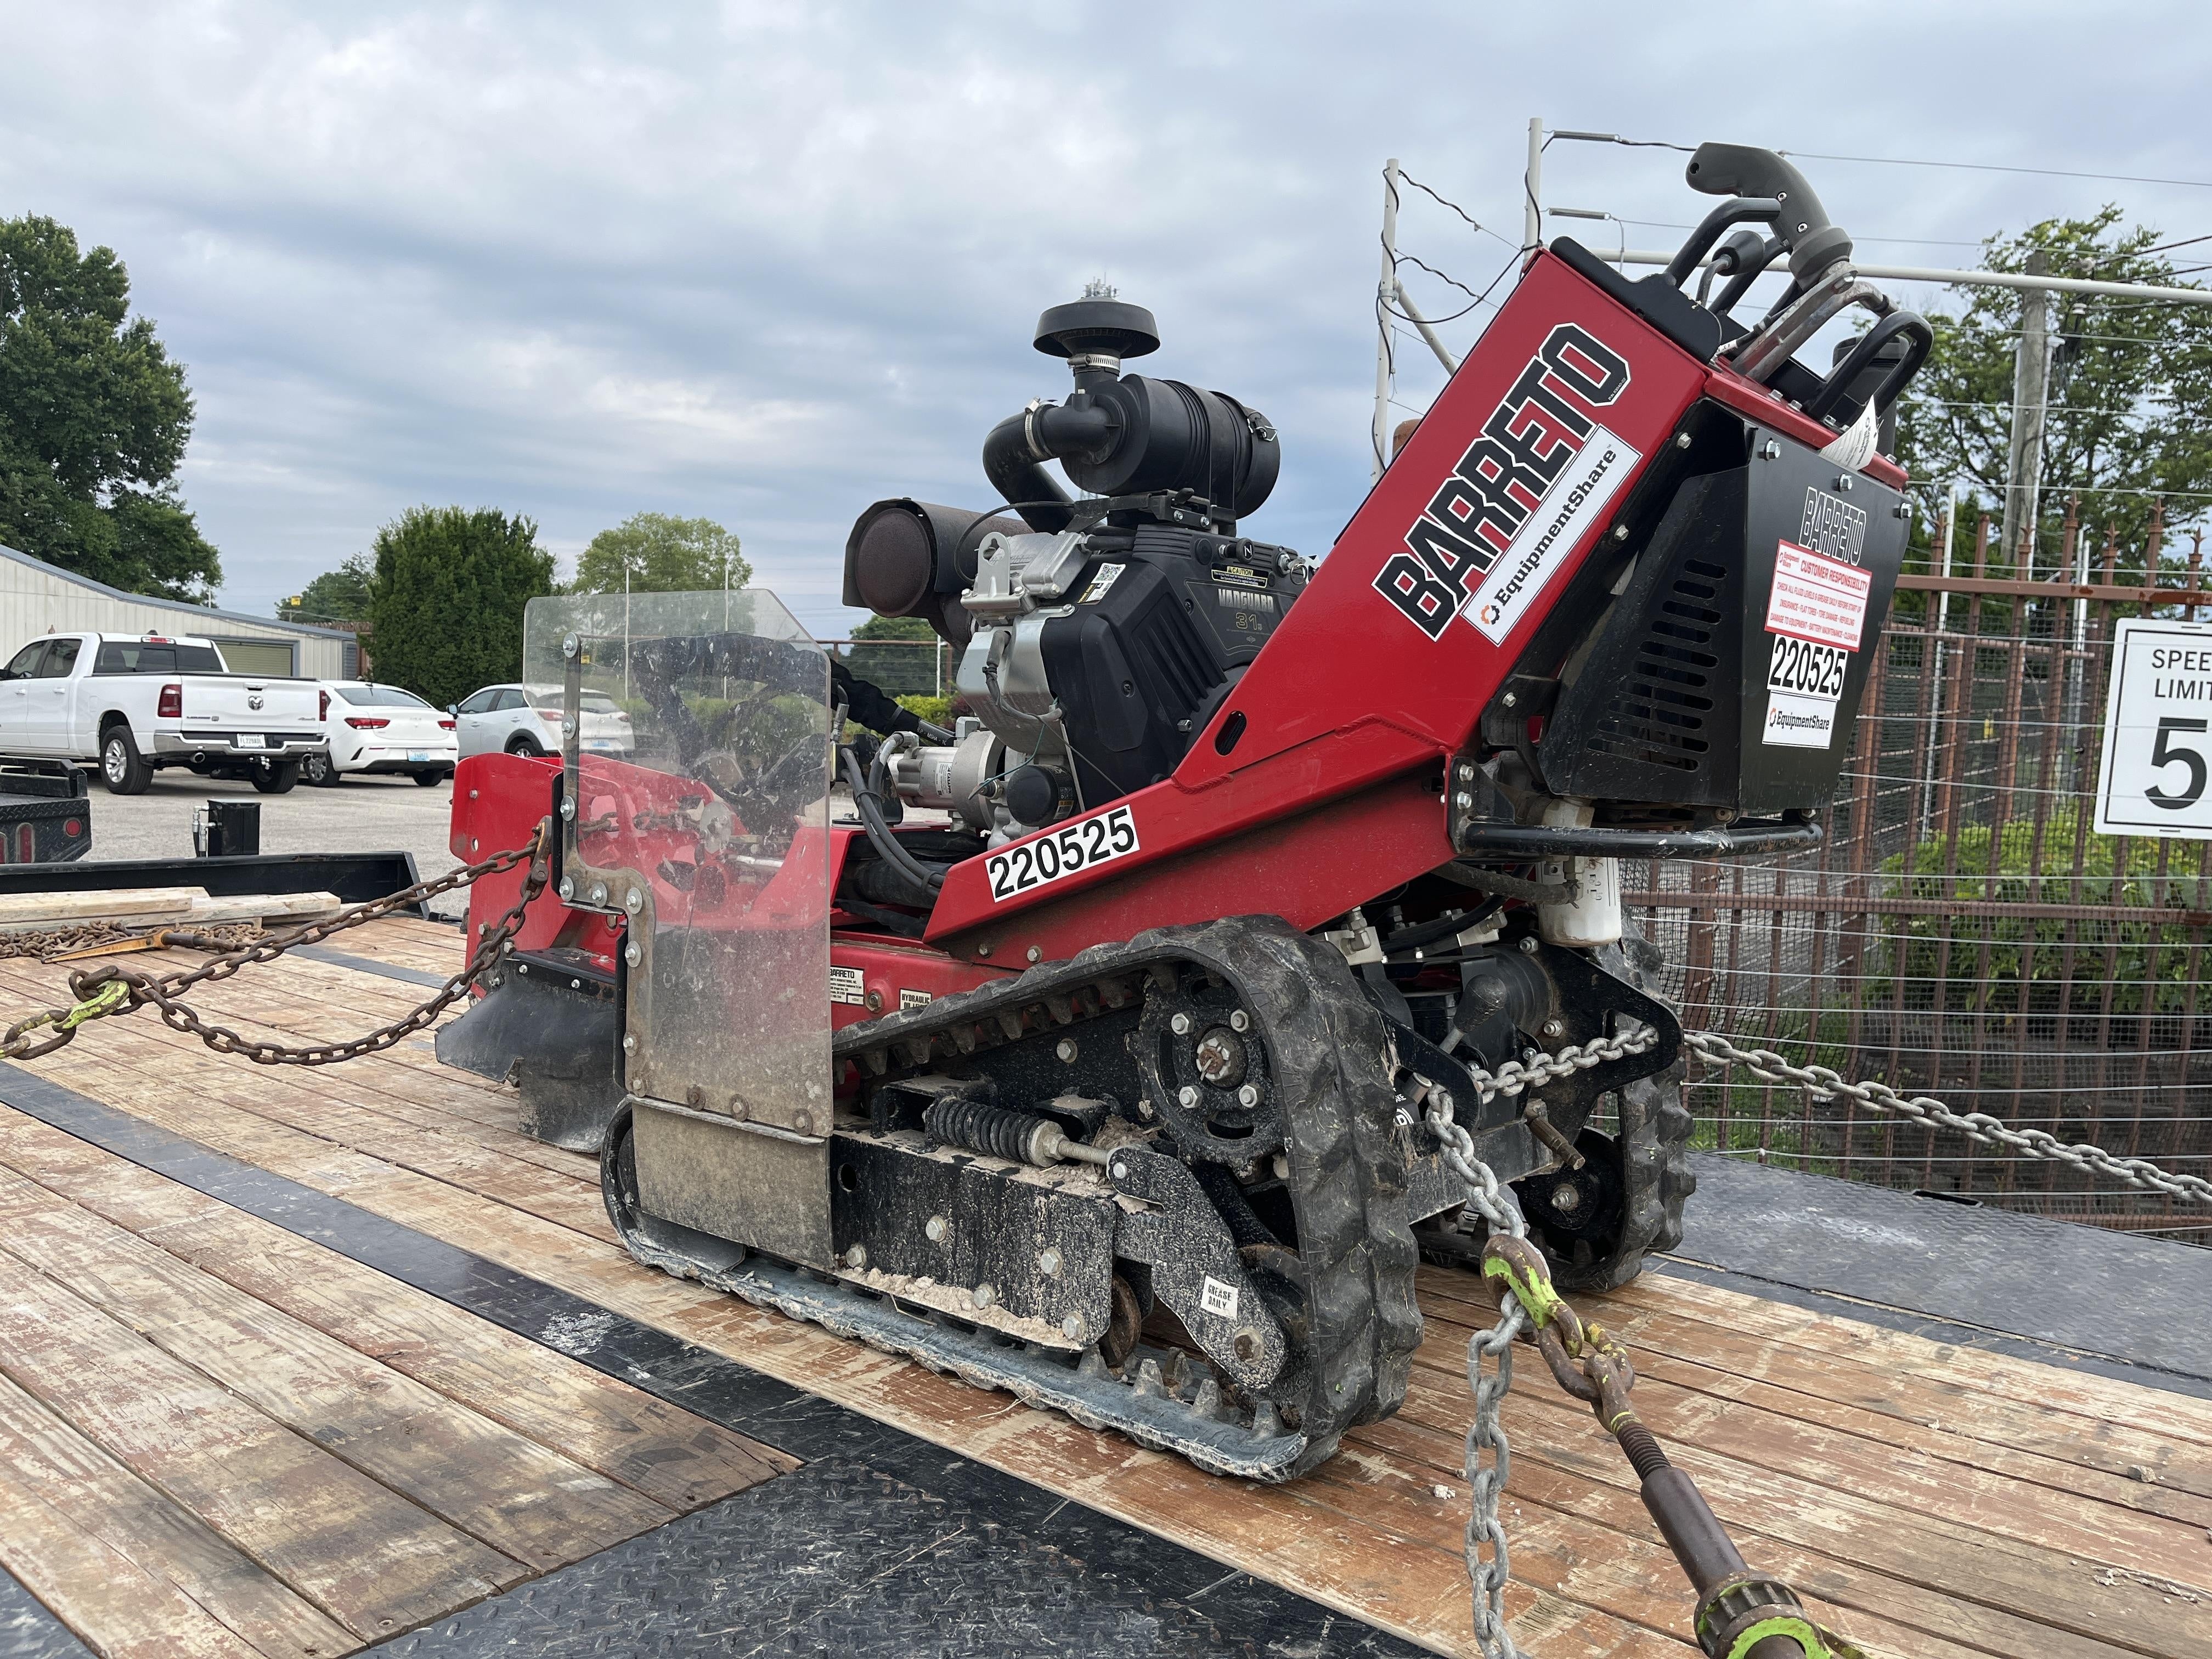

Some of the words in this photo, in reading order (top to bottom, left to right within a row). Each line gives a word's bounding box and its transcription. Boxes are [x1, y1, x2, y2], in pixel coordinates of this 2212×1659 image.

[1371, 322, 1631, 642] BARRETO
[1494, 450, 1616, 606] EquipmentShare
[1798, 486, 1867, 567] BARRETO
[1232, 567, 1252, 575] CAUTION
[1801, 560, 1829, 579] CUSTOMER
[1829, 569, 1868, 592] RESPONSIBILITY
[1218, 588, 1274, 613] VANGUARD
[1235, 612, 1257, 630] 31
[1769, 636, 1846, 696] 220525
[2152, 649, 2212, 671] SPEE
[1776, 711, 1830, 730] EquipmentShare
[2145, 716, 2208, 810] 5
[989, 808, 1135, 899] 220525
[830, 968, 855, 979] BARRETO
[901, 994, 930, 1005] HYDRAULIC
[1208, 1284, 1232, 1301] GREASE
[1208, 1295, 1227, 1309] DAILY
